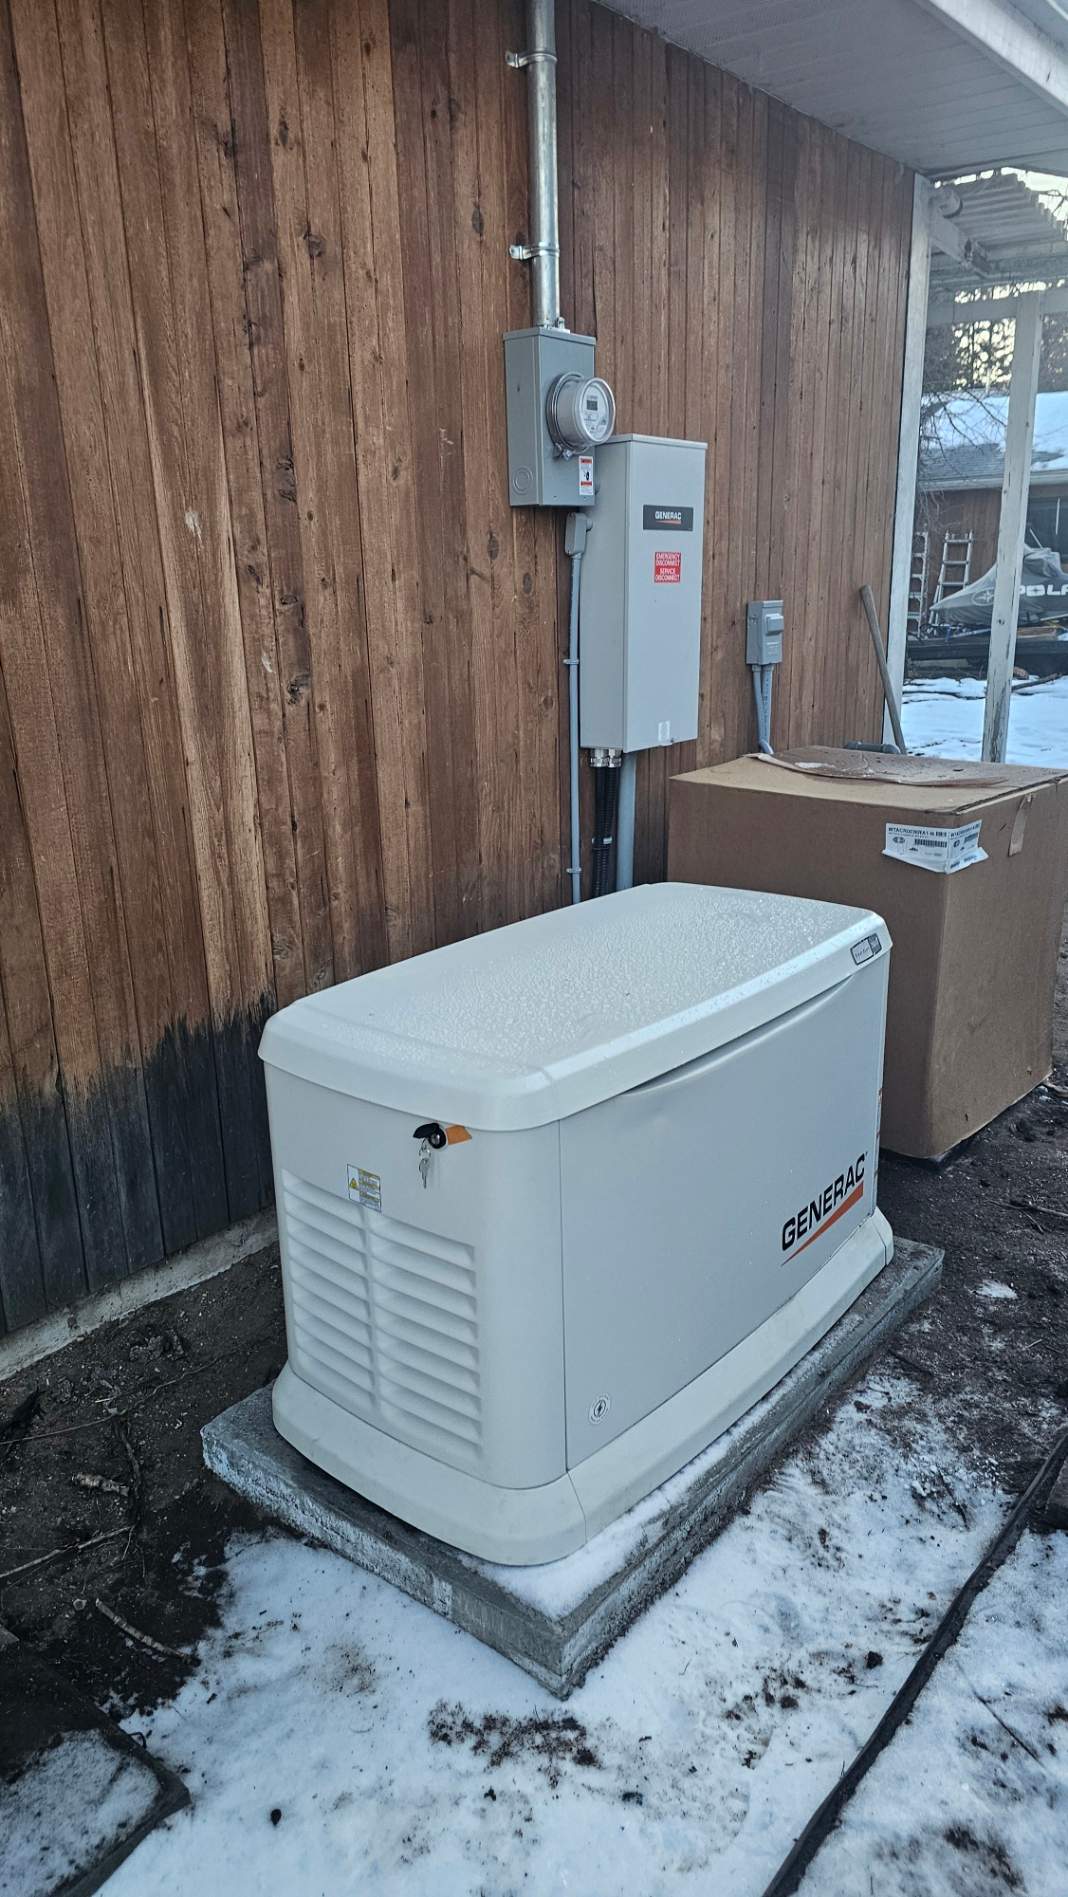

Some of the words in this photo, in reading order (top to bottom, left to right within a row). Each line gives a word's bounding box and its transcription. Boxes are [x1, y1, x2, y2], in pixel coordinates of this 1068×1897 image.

[655, 511, 681, 520] GENERAC
[660, 567, 676, 575] SERVICE
[782, 1153, 865, 1251] GENERAC
